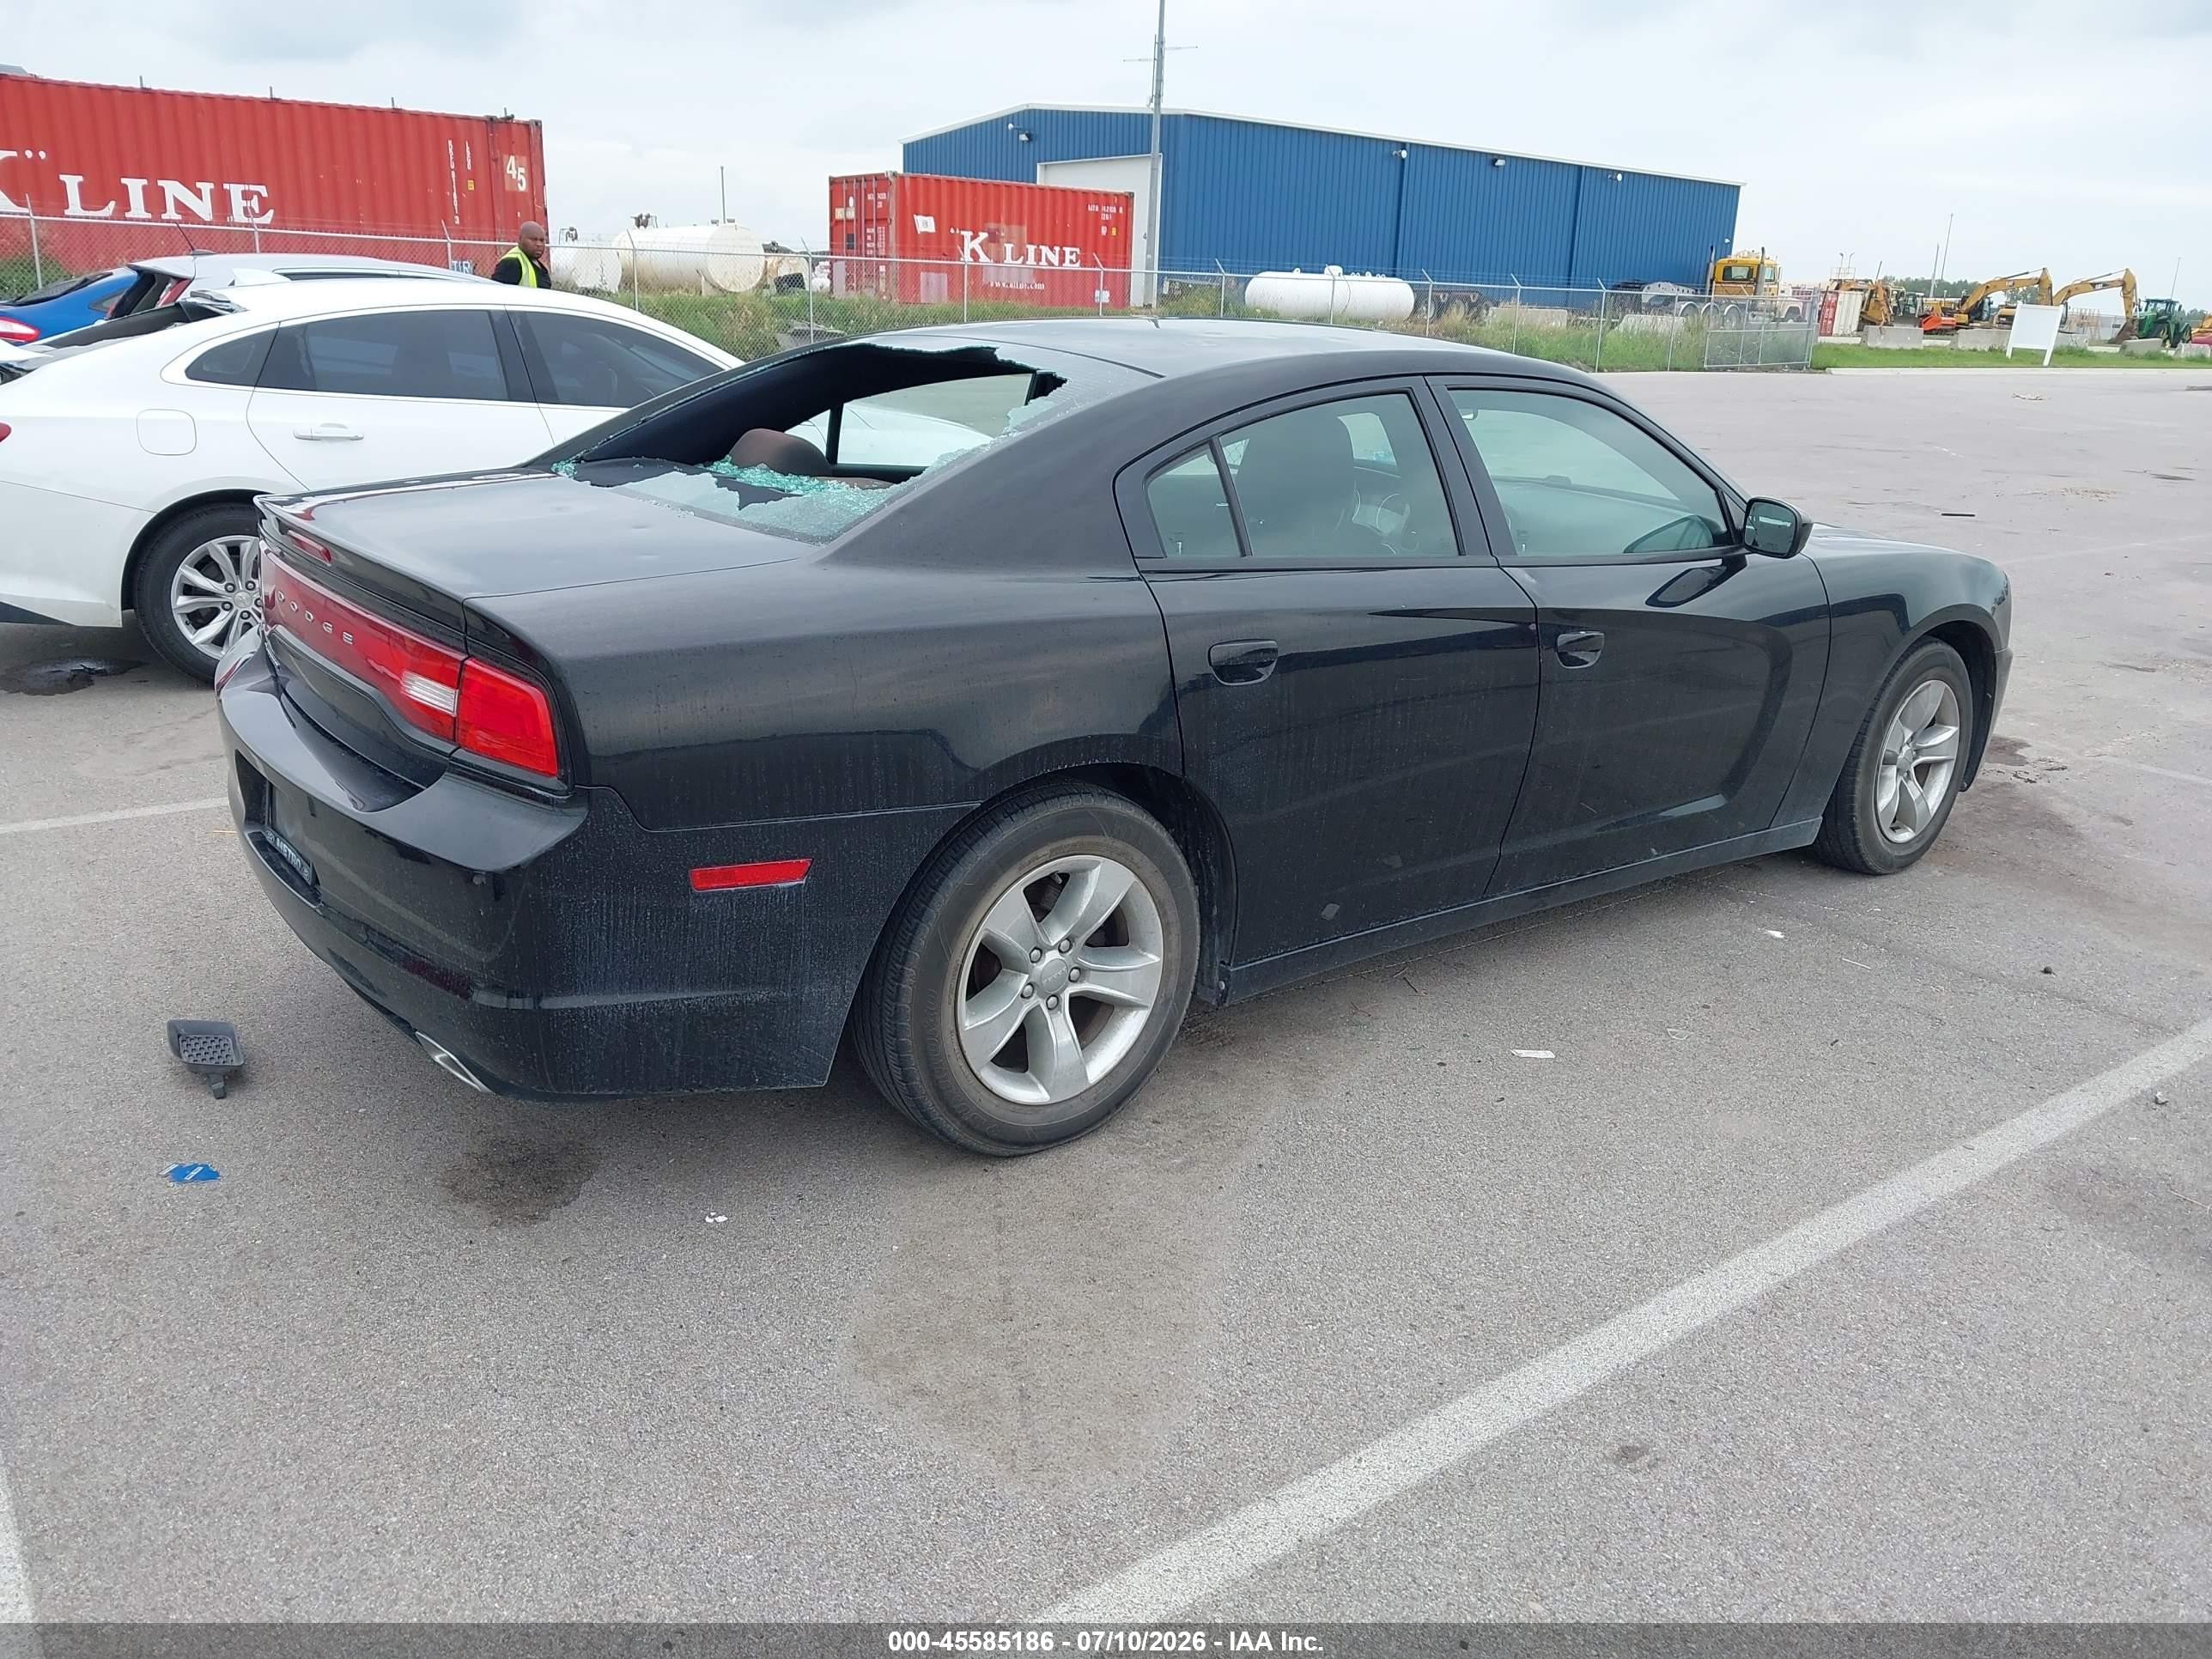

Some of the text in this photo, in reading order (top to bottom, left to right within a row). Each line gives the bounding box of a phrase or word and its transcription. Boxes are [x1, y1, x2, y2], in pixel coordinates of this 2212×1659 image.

[506, 155, 526, 193] 45
[58, 173, 275, 224] LINE
[1004, 243, 1081, 267] LINE
[277, 590, 354, 645] DODGE
[276, 837, 301, 868] METRO
